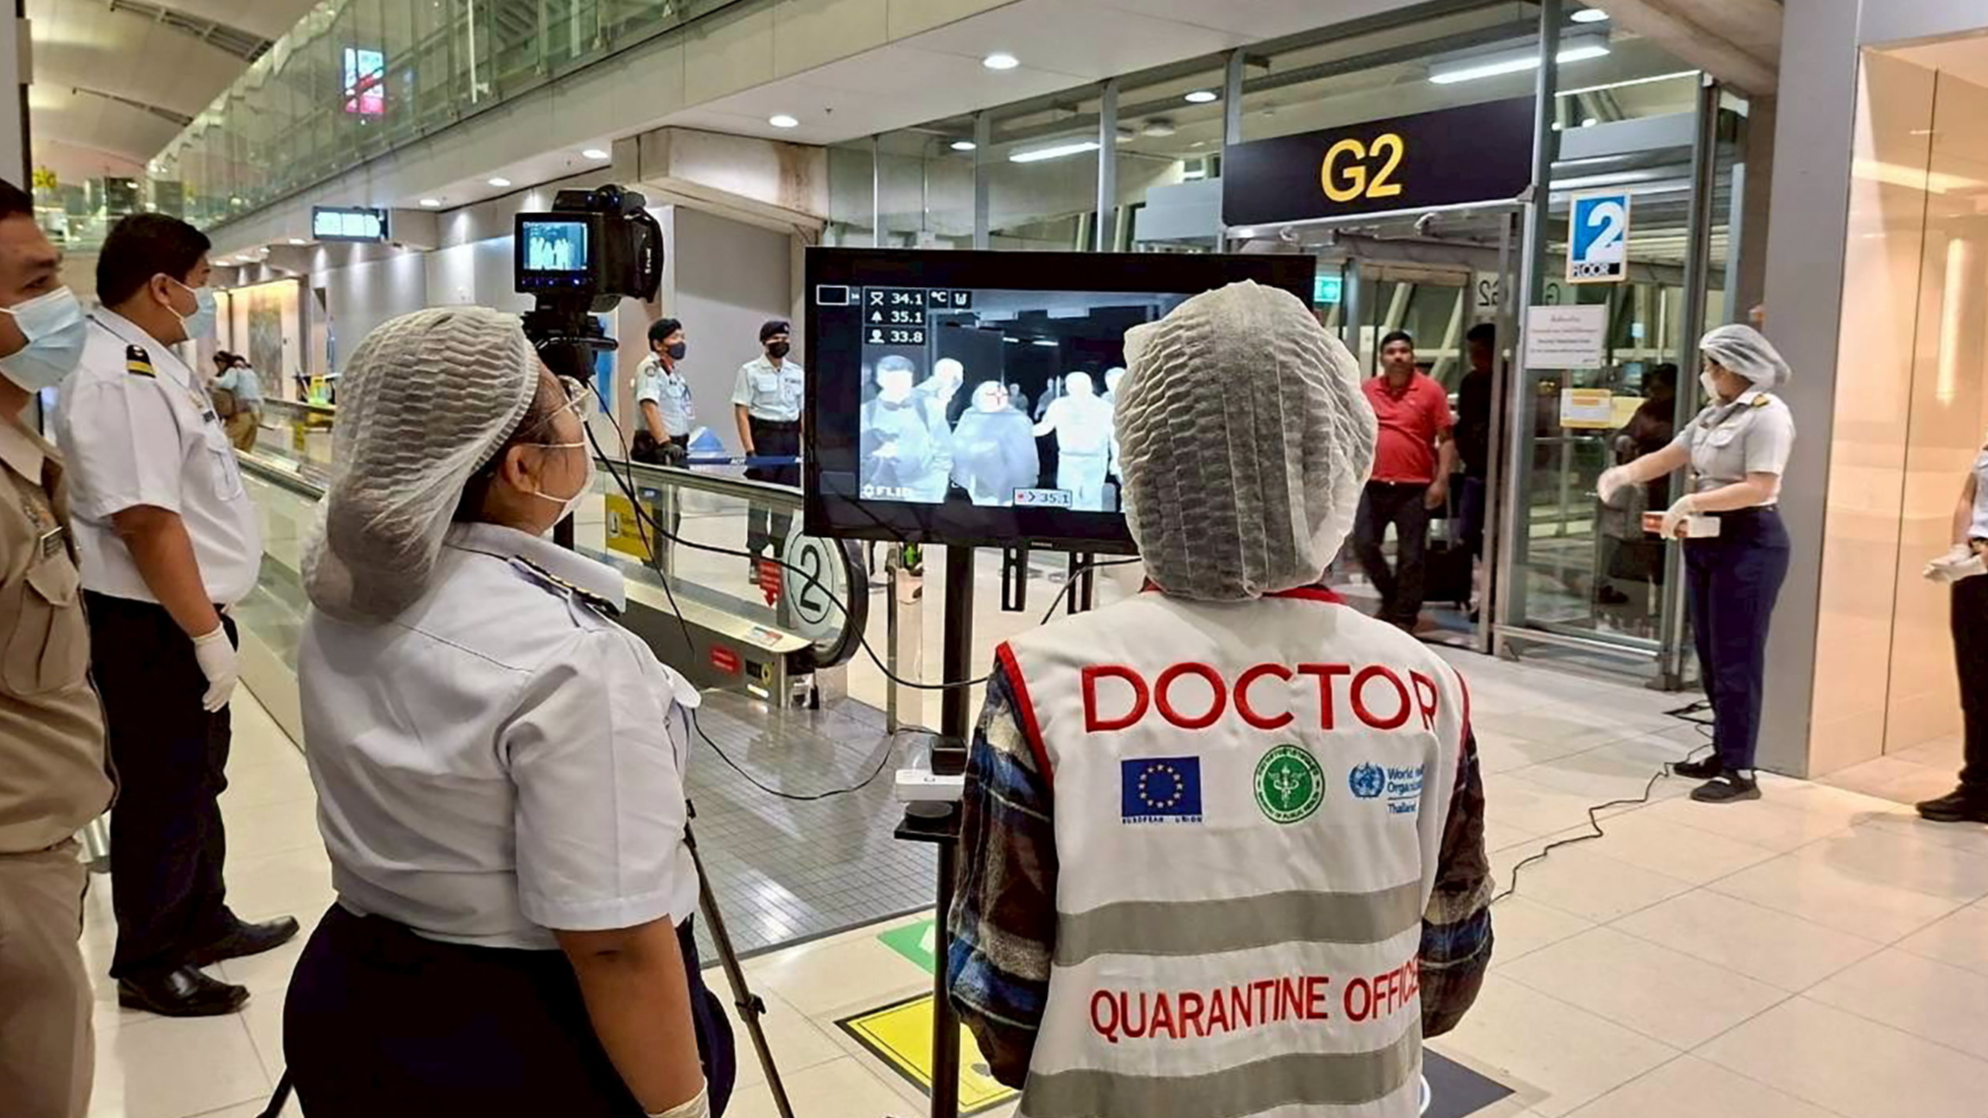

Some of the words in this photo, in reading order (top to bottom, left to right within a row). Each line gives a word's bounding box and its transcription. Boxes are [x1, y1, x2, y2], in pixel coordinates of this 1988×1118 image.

[1321, 133, 1404, 202] G2
[1584, 201, 1625, 262] 2
[890, 310, 922, 323] 35.1
[891, 292, 922, 305] 34.1
[890, 330, 923, 343] 33.8
[1039, 493, 1069, 504] 35.1
[800, 544, 821, 613] 2
[1081, 661, 1438, 734] DOCTOR
[1387, 766, 1413, 780] World
[1090, 976, 1330, 1043] QUARANTINE
